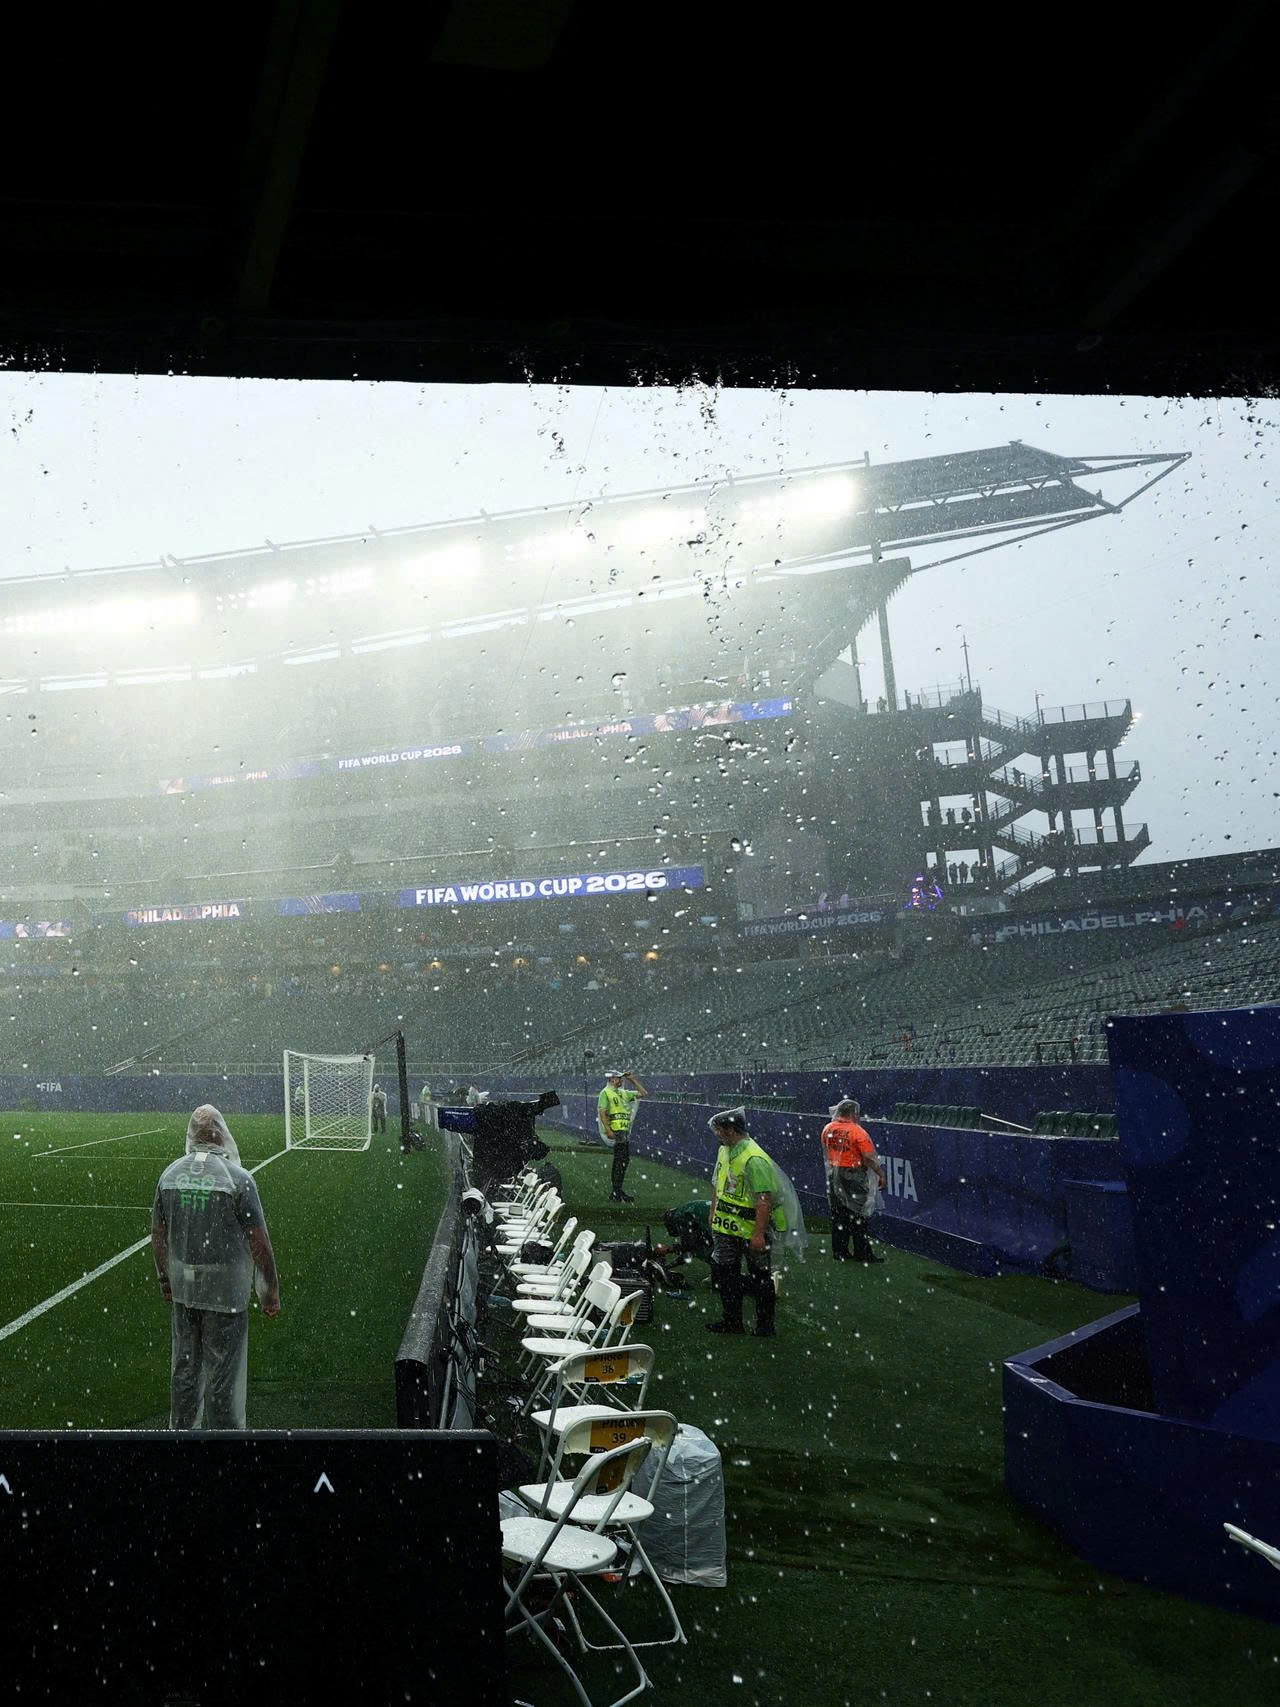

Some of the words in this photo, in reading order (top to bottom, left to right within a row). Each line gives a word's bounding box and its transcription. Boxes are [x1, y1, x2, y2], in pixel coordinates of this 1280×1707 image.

[547, 723, 633, 741] HILADPHIA
[338, 758, 361, 769] FIFA
[361, 754, 399, 767] WORLD
[400, 750, 422, 762] CUP
[423, 745, 462, 758] 2026
[415, 887, 458, 905] FIFA
[461, 881, 536, 902] WORLD
[539, 877, 582, 896] CUP
[587, 871, 667, 893] 2026
[128, 903, 240, 923] PHILADLPHIA
[745, 923, 768, 937] FIFA
[768, 919, 812, 935] WORLD
[812, 916, 835, 930] CUP
[837, 911, 882, 926] 2026
[1004, 906, 1208, 937] PHILADELPHIA
[40, 1082, 62, 1092] FIFA
[612, 1433, 626, 1443] 39
